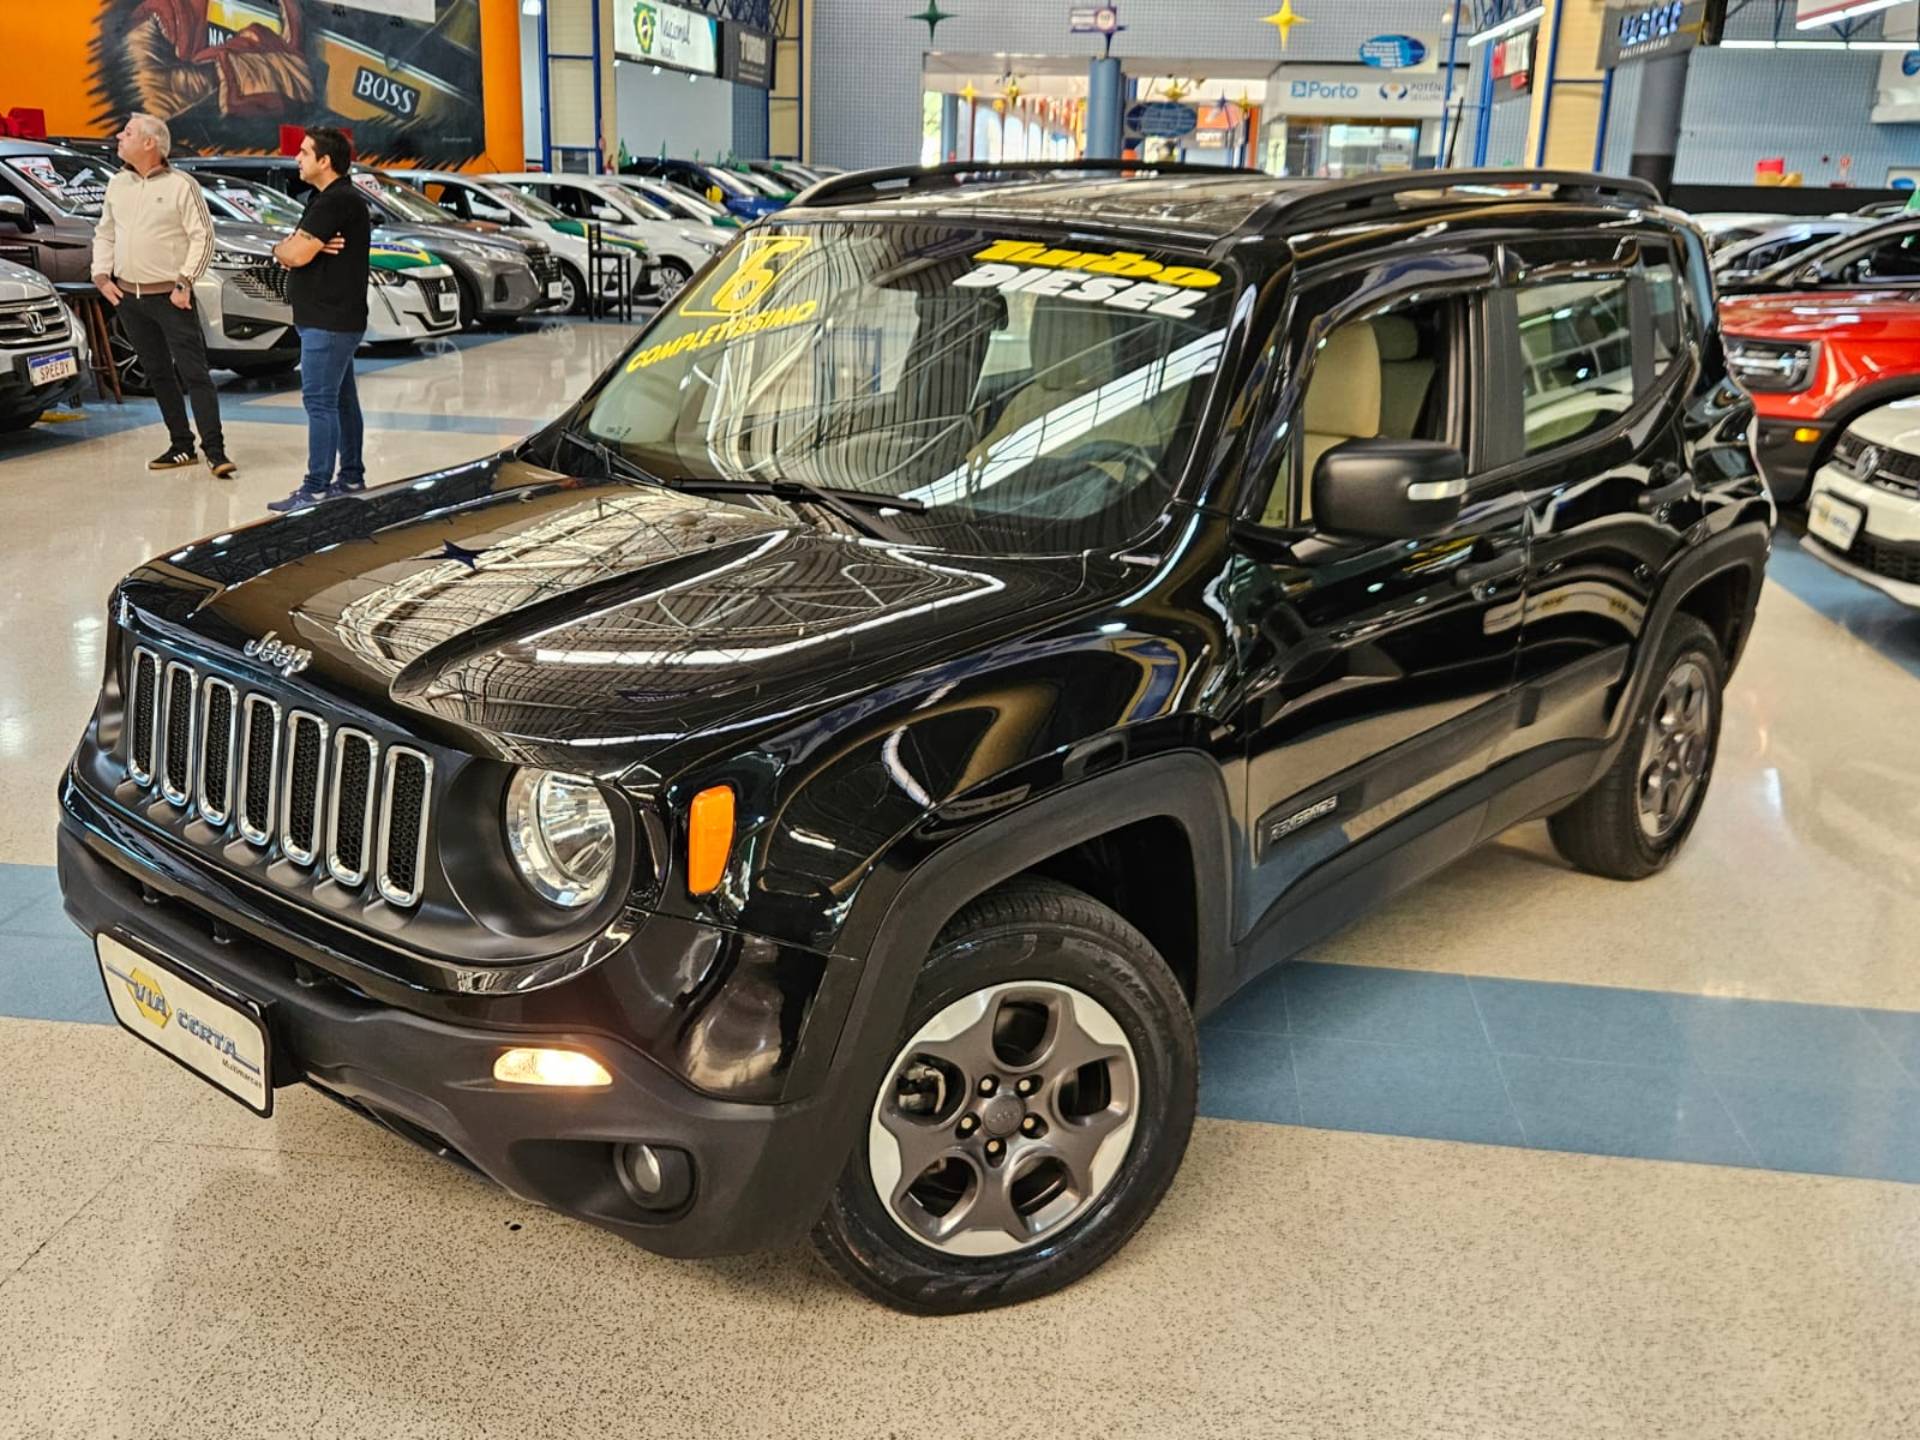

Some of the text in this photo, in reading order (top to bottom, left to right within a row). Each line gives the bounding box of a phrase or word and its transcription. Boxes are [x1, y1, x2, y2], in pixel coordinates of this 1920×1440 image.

[357, 69, 416, 114] BOSS
[1308, 81, 1358, 98] Porto
[952, 263, 1207, 319] DIESEL
[39, 361, 70, 381] SPEEDY
[243, 630, 313, 678] Jeep
[134, 982, 237, 1058] VIA CERTA
